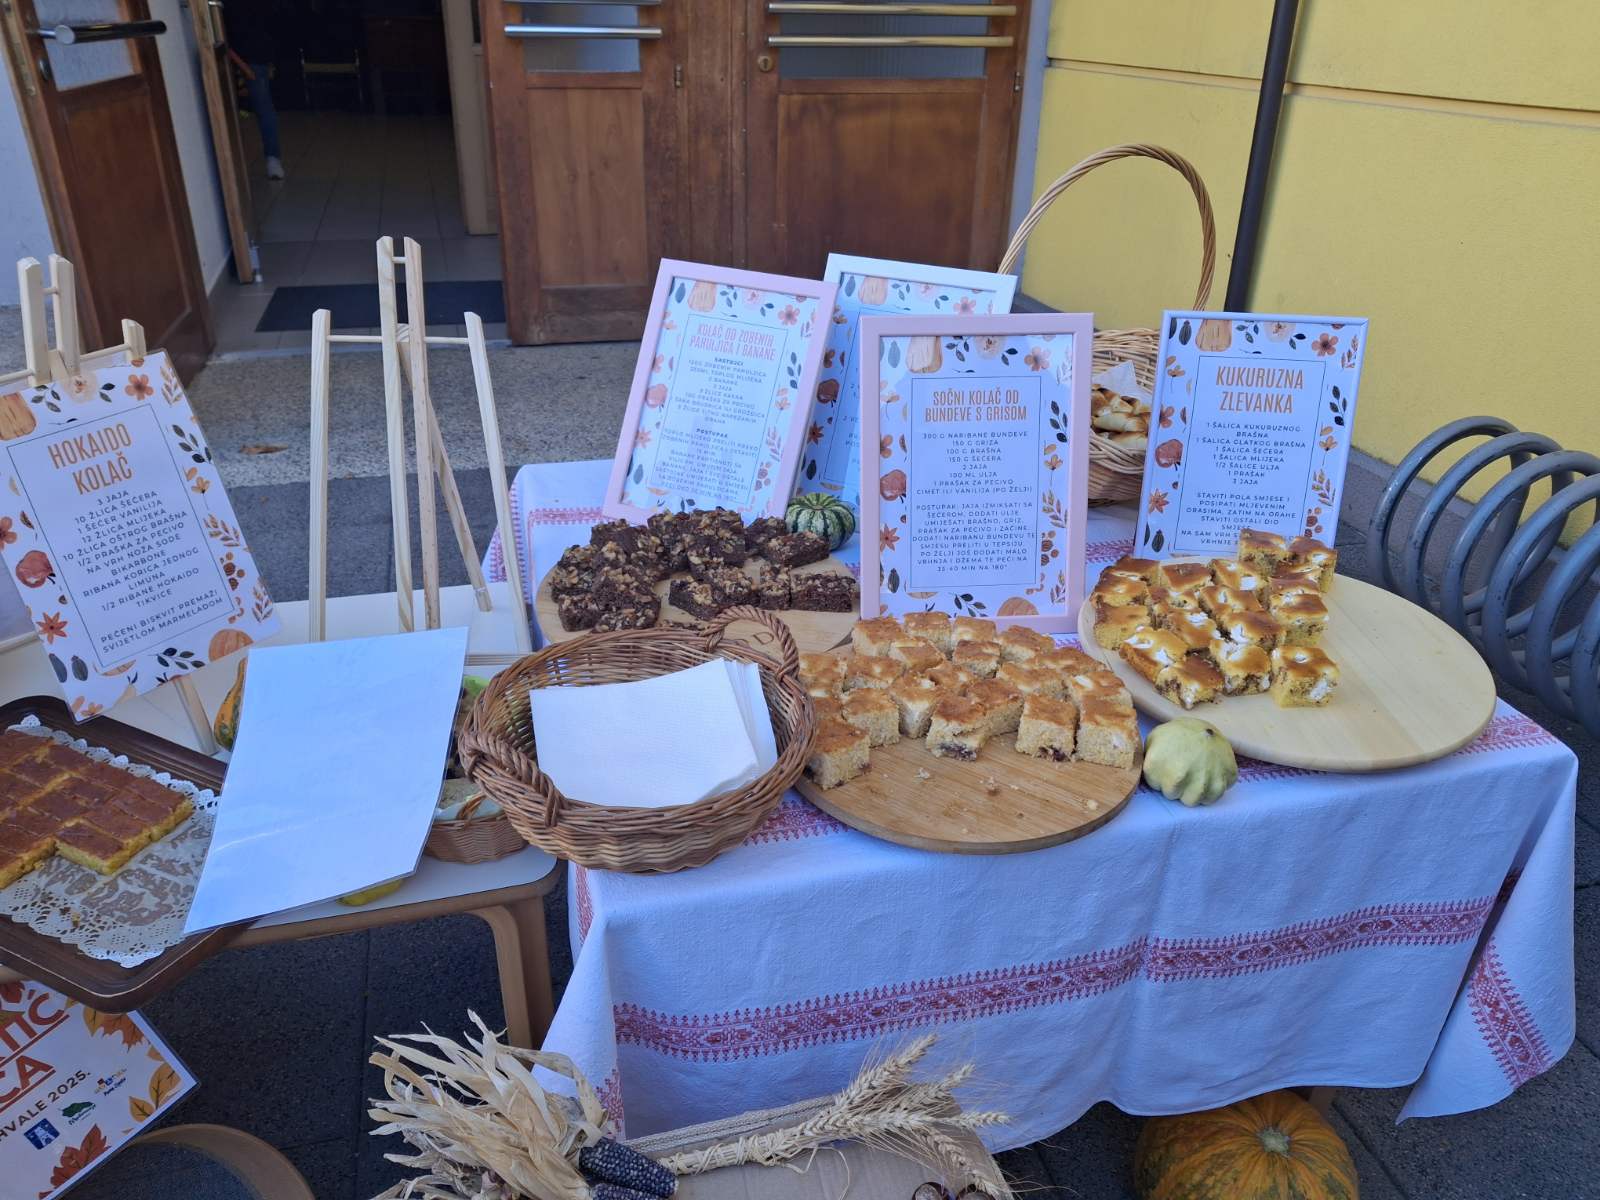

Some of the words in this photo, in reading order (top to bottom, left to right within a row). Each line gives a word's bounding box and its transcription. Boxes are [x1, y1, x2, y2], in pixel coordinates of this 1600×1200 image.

[1215, 365, 1302, 389] KUKURUZNA
[932, 387, 964, 405] SOČNI
[968, 386, 1001, 405] KOLAČ
[1005, 389, 1018, 404] OD
[1219, 390, 1292, 413] ZLEVANKA
[924, 406, 971, 422] BUNDEVE
[975, 406, 981, 421] S
[986, 405, 1026, 421] GRISOM
[47, 423, 131, 469] HOKAIDO
[71, 450, 132, 495] KOLAČ
[74, 515, 86, 524] 10
[88, 504, 118, 519] ŽLICA
[120, 490, 157, 508] ŠEĆERA
[105, 490, 128, 502] JAJA
[81, 535, 91, 543] 12
[94, 523, 124, 539] ŽLICA
[126, 508, 166, 527] MLIJEKA
[84, 515, 117, 531] ŠEĆER
[119, 499, 162, 518] VANILIJA
[62, 553, 73, 561] 10
[76, 541, 106, 556] ŽLICA
[108, 525, 147, 544] OŠTROG
[150, 510, 187, 528] BRAŠNA
[77, 557, 91, 566] 1/2
[94, 541, 133, 560] PRAŠKA
[135, 536, 148, 544] ZA
[150, 521, 184, 539] PECIVO
[86, 564, 101, 574] NA
[103, 555, 124, 567] VRH
[127, 544, 153, 558] NOŽA
[155, 532, 180, 547] SODE
[110, 549, 165, 576] BIKARBONE
[82, 578, 121, 597] RIBANA
[123, 563, 159, 581] KORICA
[162, 546, 198, 566] JEDNOG
[128, 571, 165, 590] LIMUNA
[101, 601, 115, 611] 1/2
[118, 585, 153, 604] RIBANE
[156, 567, 199, 588] HOKAIDO
[135, 588, 172, 607] TIKVICE
[100, 623, 137, 642] PEČENI
[139, 606, 174, 627] BISKVIT
[177, 589, 217, 609] PREMAŽI
[102, 626, 155, 653] SVIJETLOM
[158, 596, 222, 628] MARMELADOM
[47, 1069, 91, 1103] 2025.
